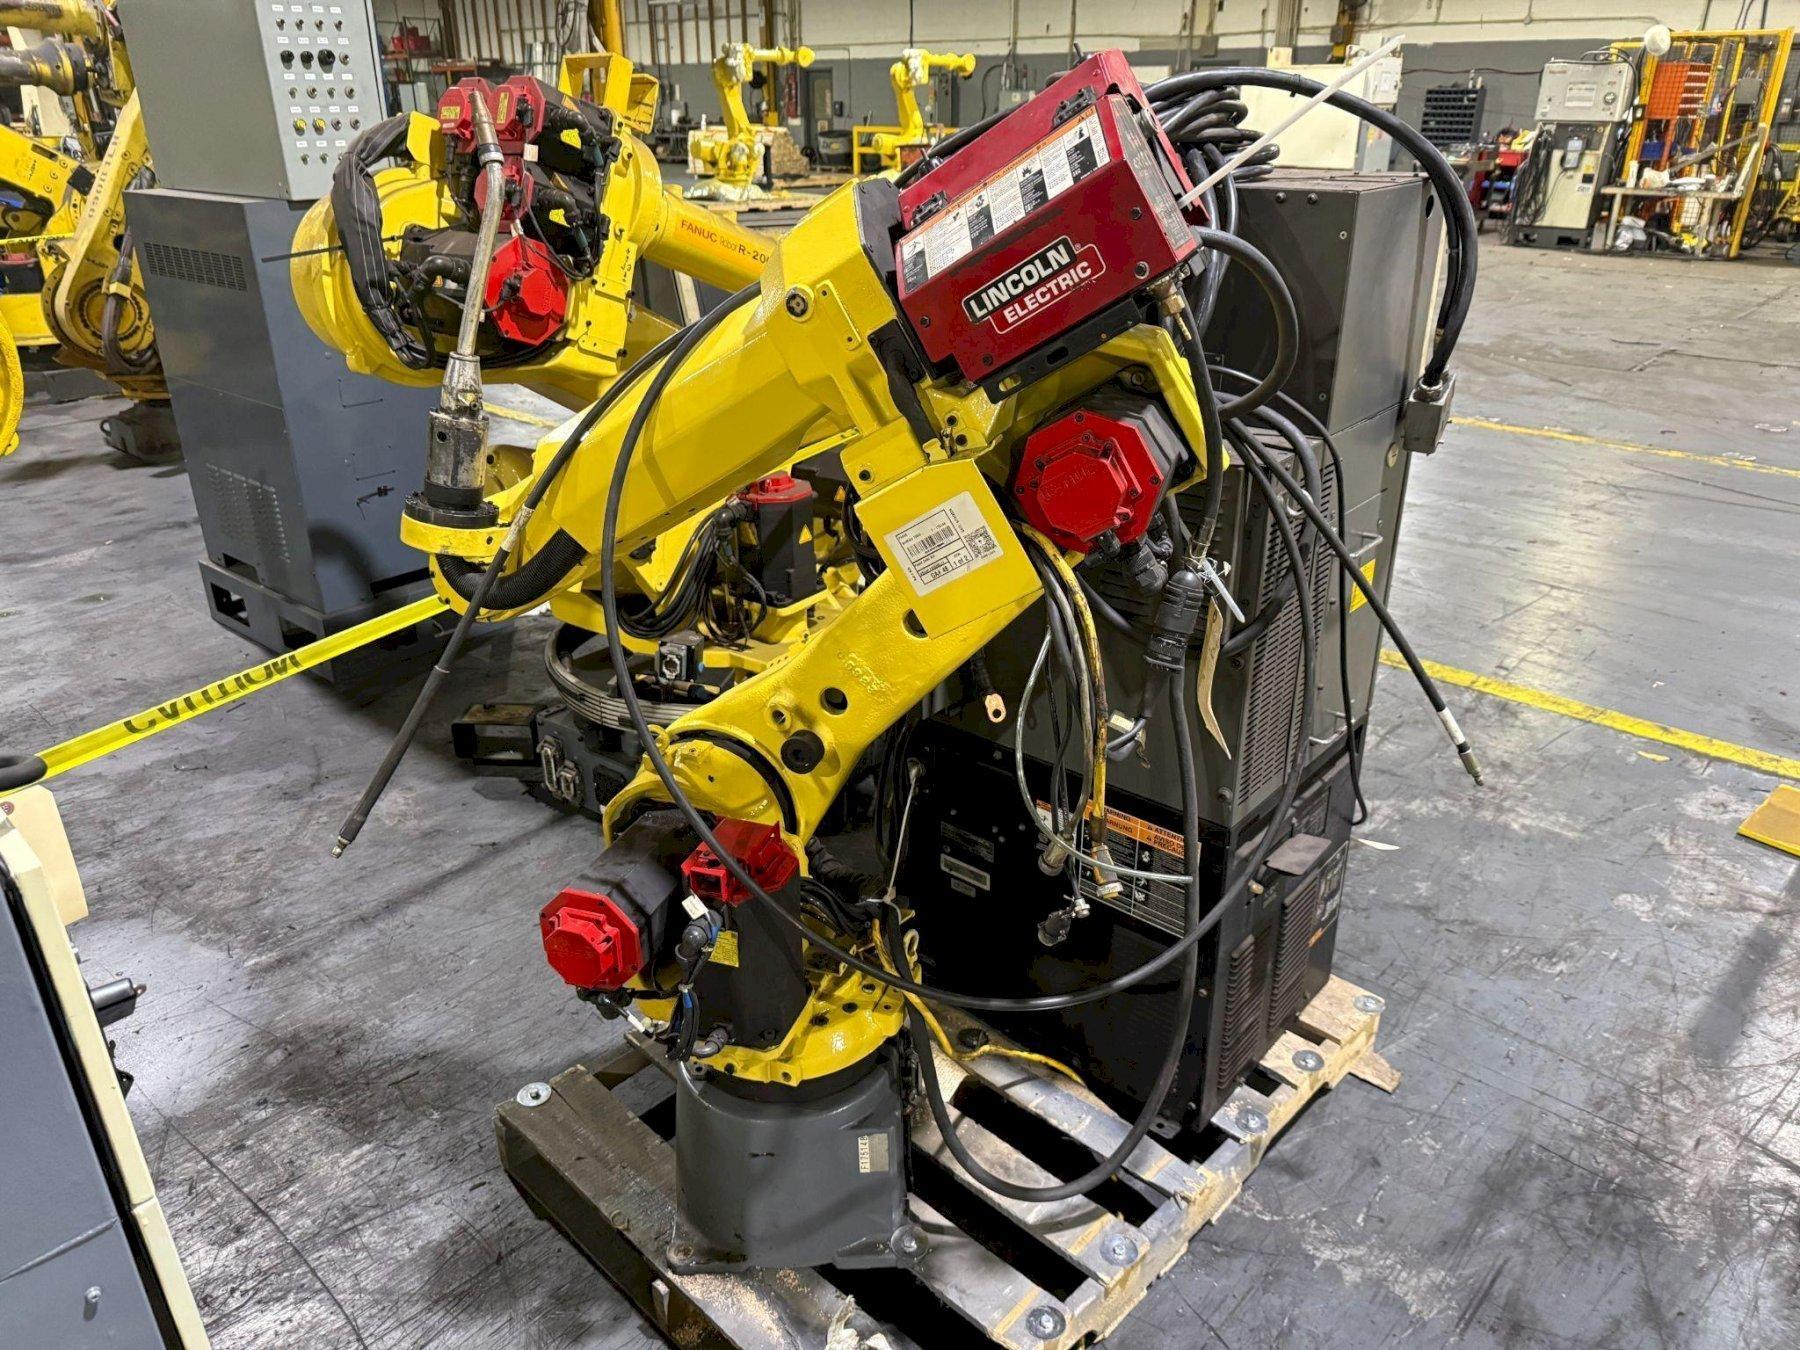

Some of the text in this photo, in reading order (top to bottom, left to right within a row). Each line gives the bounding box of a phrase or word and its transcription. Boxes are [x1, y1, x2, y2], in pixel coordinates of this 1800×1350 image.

[681, 219, 717, 243] FANUC
[738, 243, 770, 265] R-20
[968, 243, 1071, 319] LINCOLN
[1002, 261, 1092, 324] ELECTRIC
[1104, 806, 1131, 822] ARNING
[1105, 818, 1133, 834] ARNUNG
